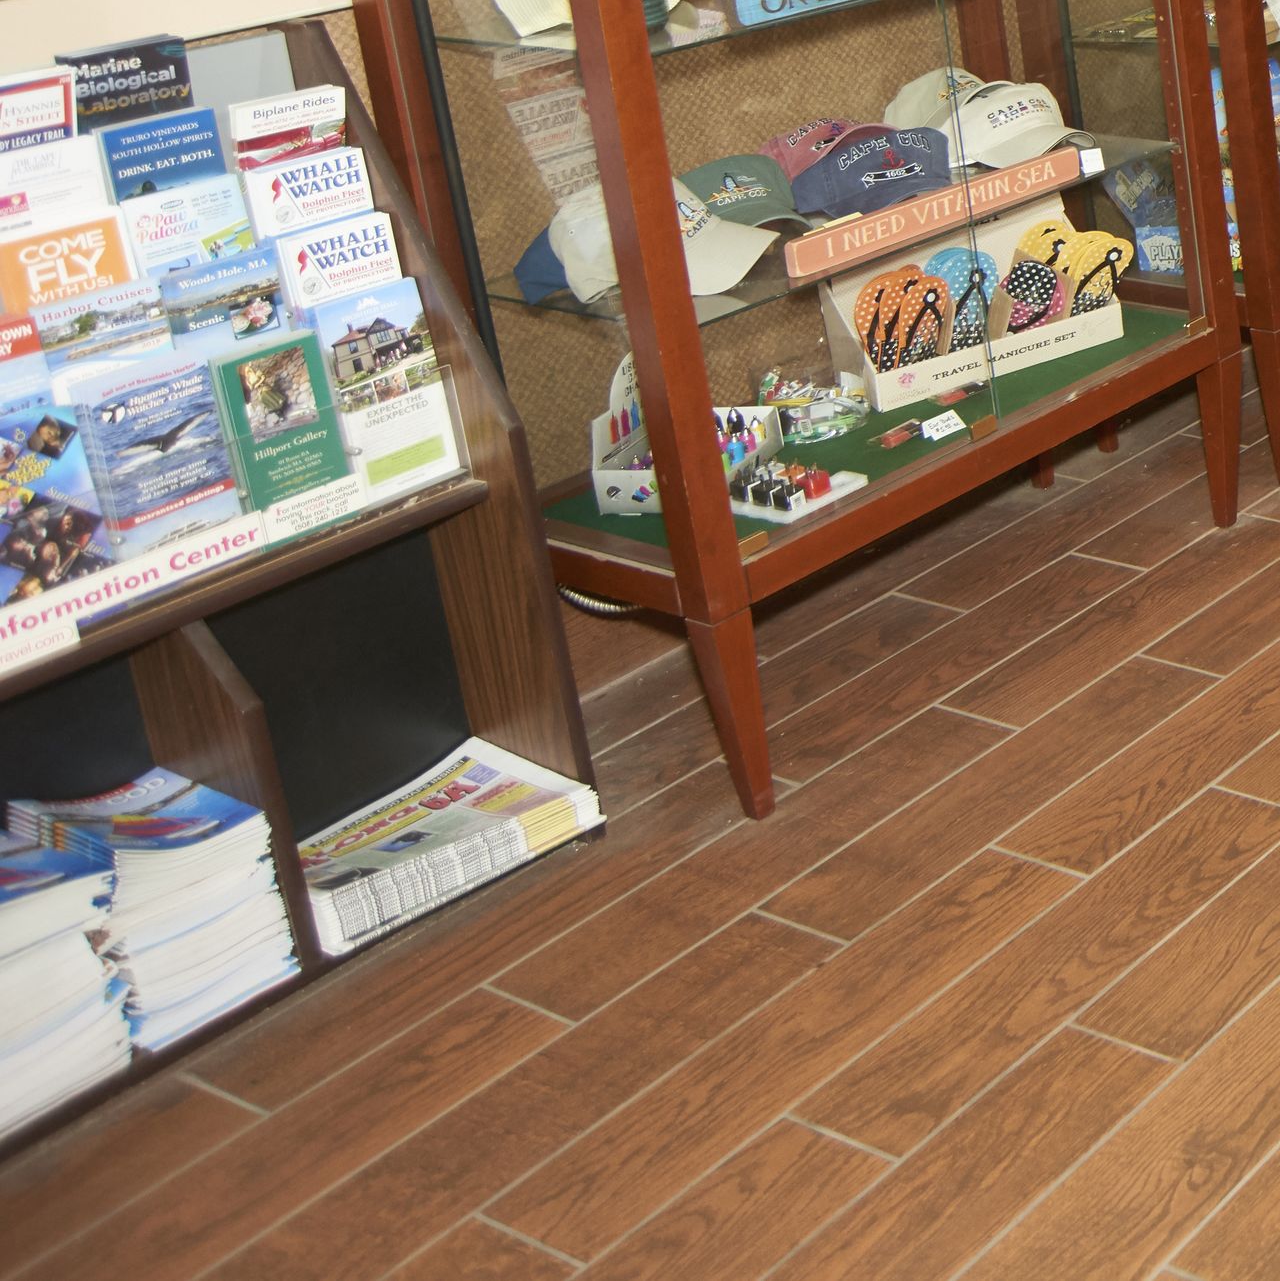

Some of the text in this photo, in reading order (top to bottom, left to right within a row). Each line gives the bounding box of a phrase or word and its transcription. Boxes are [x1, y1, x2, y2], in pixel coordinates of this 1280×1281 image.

[75, 56, 142, 81] Marine
[76, 65, 176, 99] Biological
[78, 82, 191, 116] Laboratory
[253, 95, 336, 120] Biplane Rides
[987, 101, 1024, 120] CAPE
[12, 128, 65, 148] LEGACY TRAIL
[112, 131, 214, 162] SOUTH HOLLOW SPIRITS
[120, 121, 199, 146] TRURO VINEYARDS
[118, 149, 215, 179] DRINK. EAT. BOTH.
[838, 132, 932, 170] CAPE COD
[281, 153, 360, 185] WHALE
[289, 169, 362, 200] WATCH
[883, 169, 906, 178] 1602
[302, 187, 365, 209] Dolphin Fleet
[717, 189, 768, 206] CAPE COD
[826, 161, 1057, 259] I NEED VITAMIN SEA
[307, 223, 387, 255] WHALE
[686, 215, 709, 239] CAPE
[19, 229, 106, 264] COME
[315, 238, 390, 270] WATCH
[27, 248, 106, 293] FLY
[178, 258, 268, 291] Woods Hole, MA
[329, 256, 393, 281] Dolphin Fleet
[29, 274, 114, 305] WITH US!
[41, 286, 153, 323] Harbor Cruises
[188, 314, 225, 331] Scenic
[932, 331, 1077, 381] TRAVEL MANICURE SET
[129, 374, 203, 407] Hyannis Whale
[168, 384, 203, 401] Cruises
[366, 392, 424, 419] EXPECT THE
[364, 400, 429, 429] UNEXPECTED
[255, 429, 328, 461] Hillport Gallery
[134, 485, 224, 524] Guaranteed Sightings
[276, 511, 303, 524] having
[304, 500, 325, 512] YOUR
[326, 488, 360, 504] brochure
[291, 492, 334, 510] information
[335, 481, 356, 493] about
[335, 500, 349, 508] call
[169, 527, 259, 571] Center
